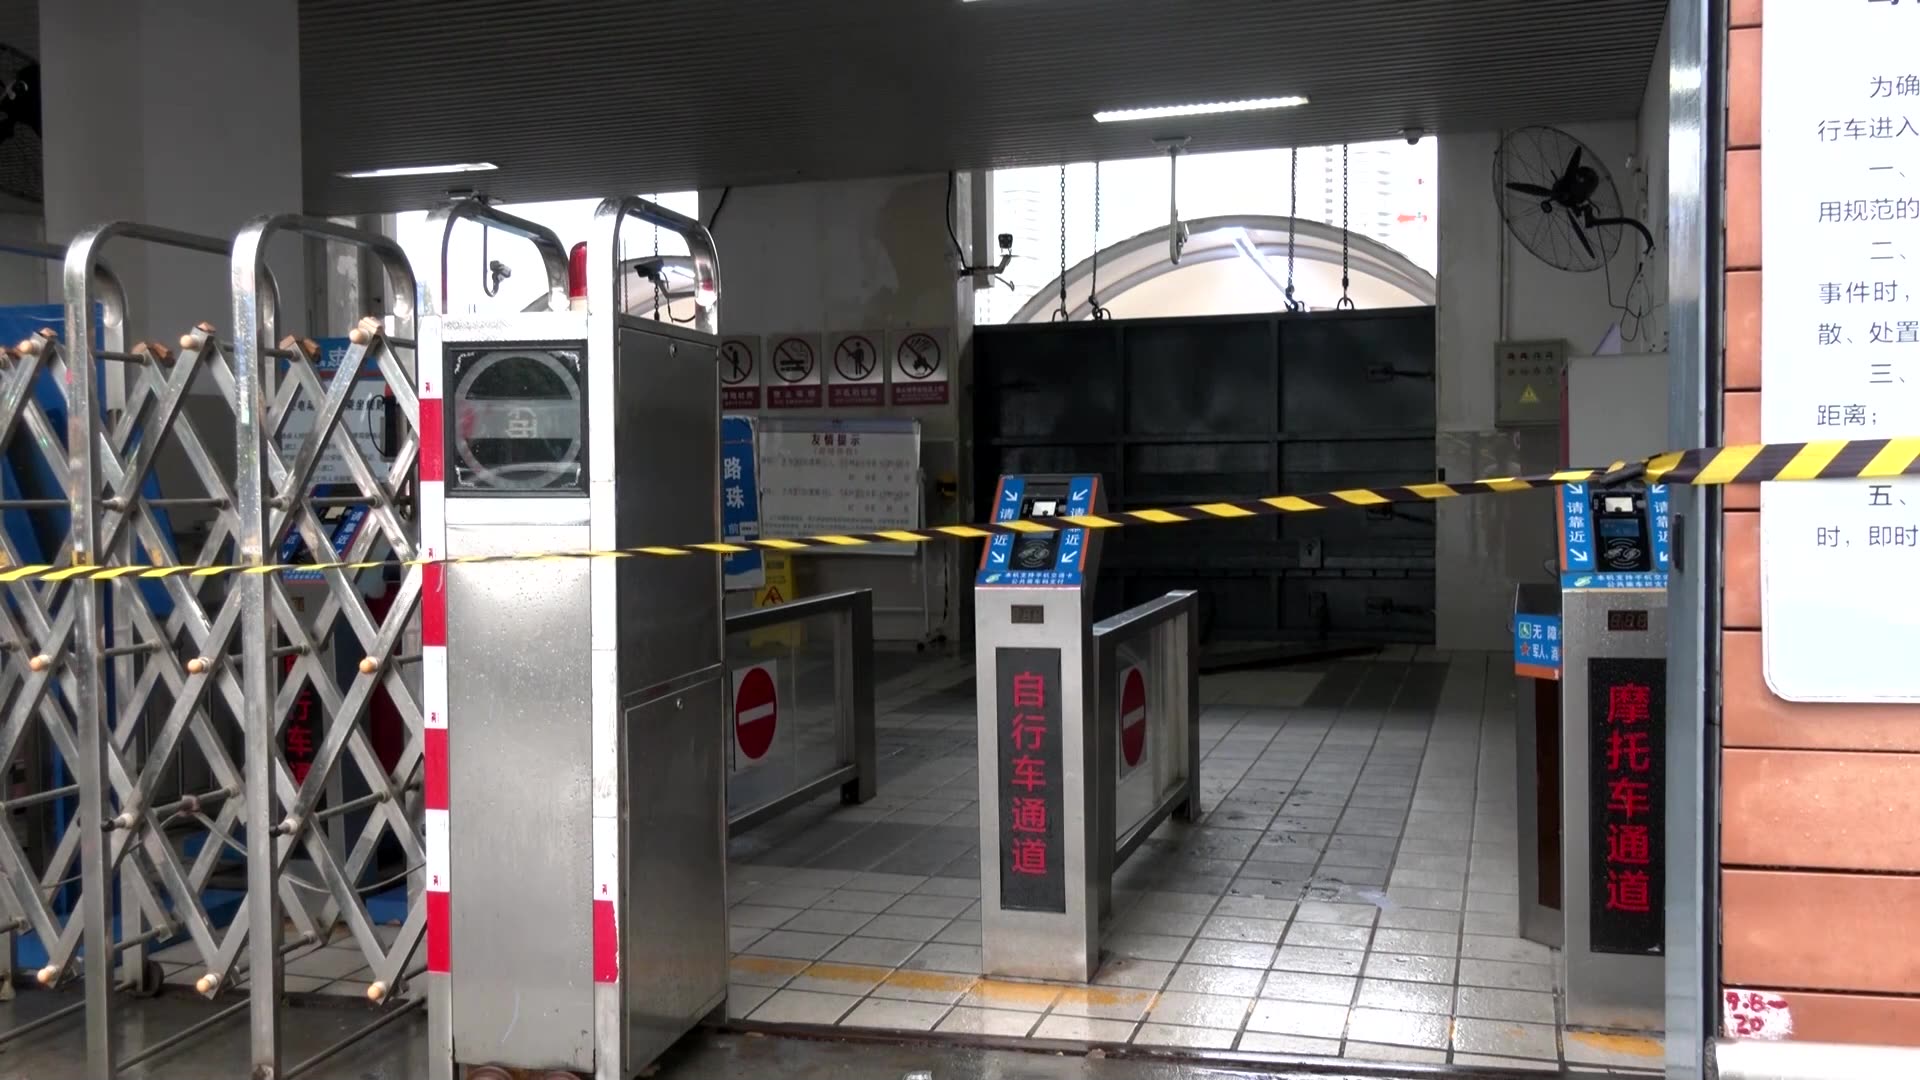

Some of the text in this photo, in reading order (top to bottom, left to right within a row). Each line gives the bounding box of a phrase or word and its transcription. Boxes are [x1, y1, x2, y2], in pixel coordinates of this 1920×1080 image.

[1870, 74, 1920, 98] 为确
[1818, 116, 1919, 142] 行车进入
[1869, 166, 1905, 178] 一、
[1819, 198, 1920, 222] 用规范的
[1870, 241, 1906, 260] 二、
[1819, 280, 1909, 305] 事件时，
[1818, 321, 1920, 345] 散、处置
[1869, 363, 1905, 384] 三、
[1817, 404, 1877, 426] 距离；
[1868, 485, 1906, 506] 五、
[993, 508, 1014, 546] 请近
[1065, 507, 1085, 546] 请近
[1567, 501, 1585, 543] 请靠近
[1817, 525, 1919, 547] 时，即时
[1533, 624, 1561, 641] 无障
[1011, 671, 1047, 876] 自行车通道
[1607, 682, 1650, 913] 摩托车通道
